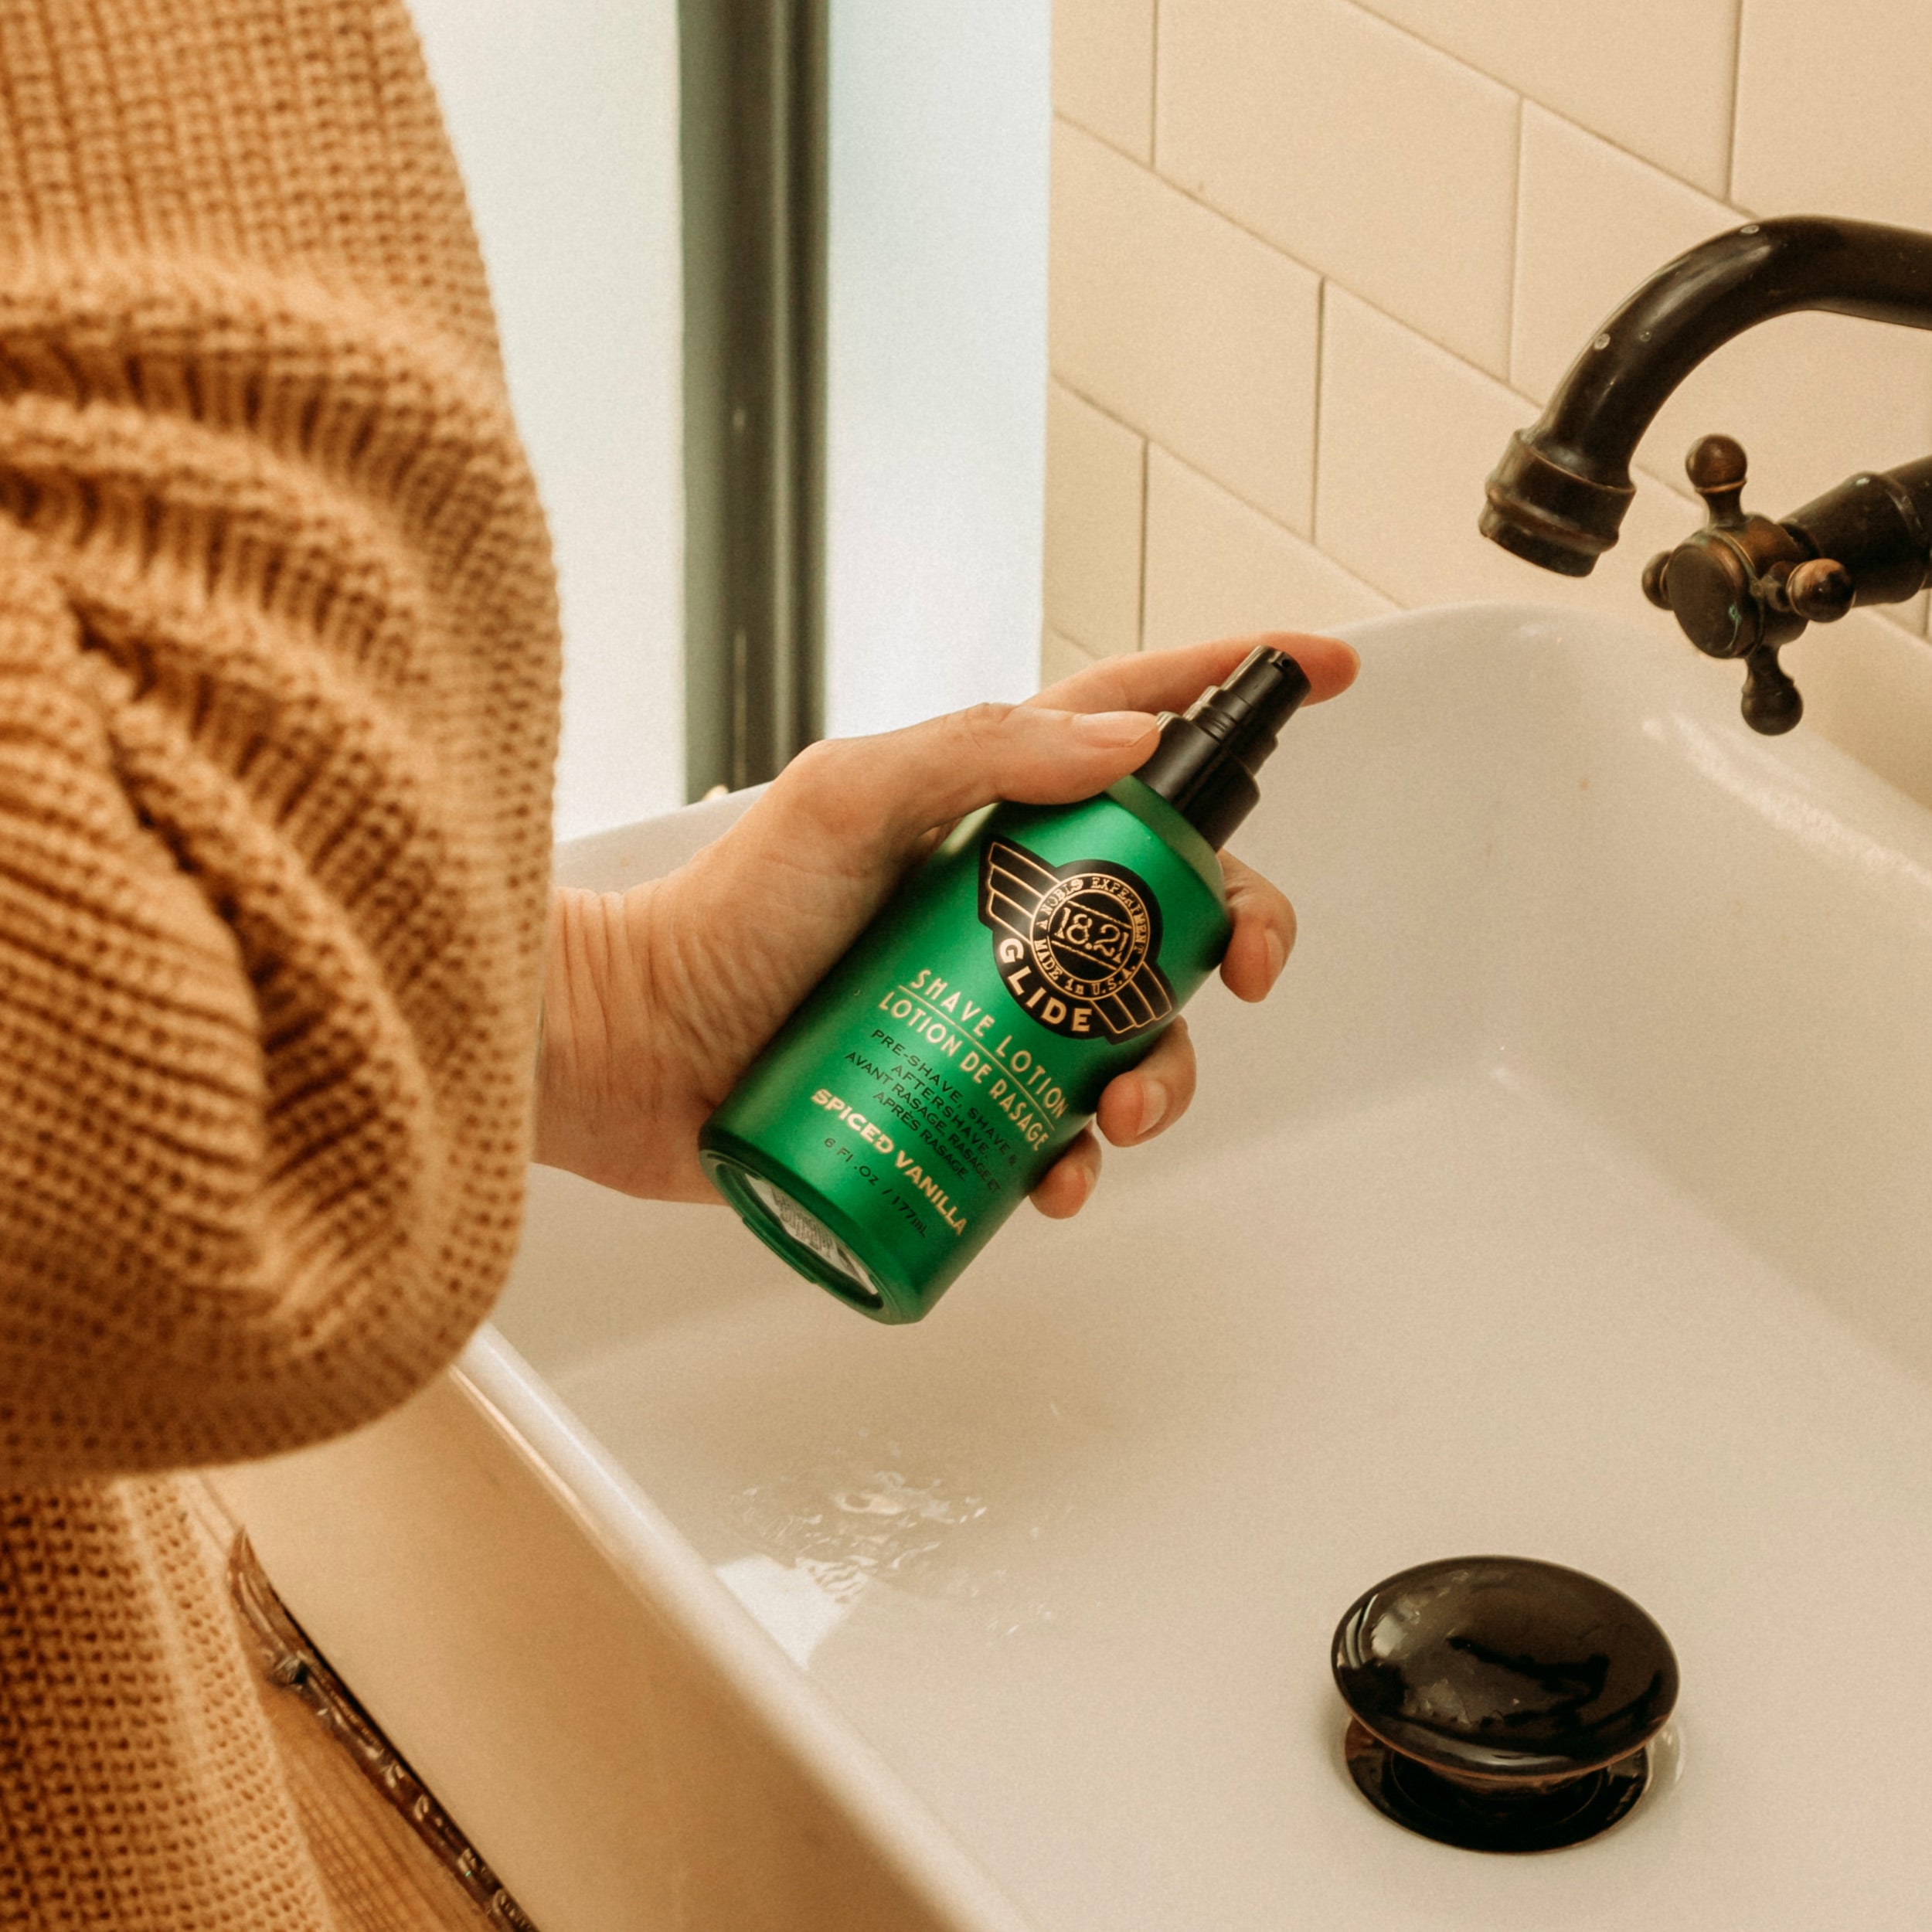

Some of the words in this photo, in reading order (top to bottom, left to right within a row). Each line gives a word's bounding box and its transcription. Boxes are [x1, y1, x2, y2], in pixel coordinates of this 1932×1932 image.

[1034, 938, 1063, 981] MADE
[1036, 920, 1048, 930] A
[999, 938, 1092, 1032] GLIDE
[871, 1029, 963, 1108] PRE-SHAVE,
[968, 1107, 1011, 1155] SHAVE
[878, 991, 962, 1056] LOTION
[961, 1051, 992, 1084] DE
[989, 1080, 1049, 1151] RASAGE
[910, 969, 995, 1037] SHAVE
[998, 1035, 1070, 1119] LOTION
[810, 1088, 895, 1154] SPICED
[894, 1150, 968, 1236] VANILLA
[825, 1138, 836, 1148] 6
[845, 1052, 893, 1085] AVANT
[948, 1133, 990, 1181] RASAGE
[873, 1091, 921, 1131] APRÈS
[920, 1131, 968, 1181] RASAGE
